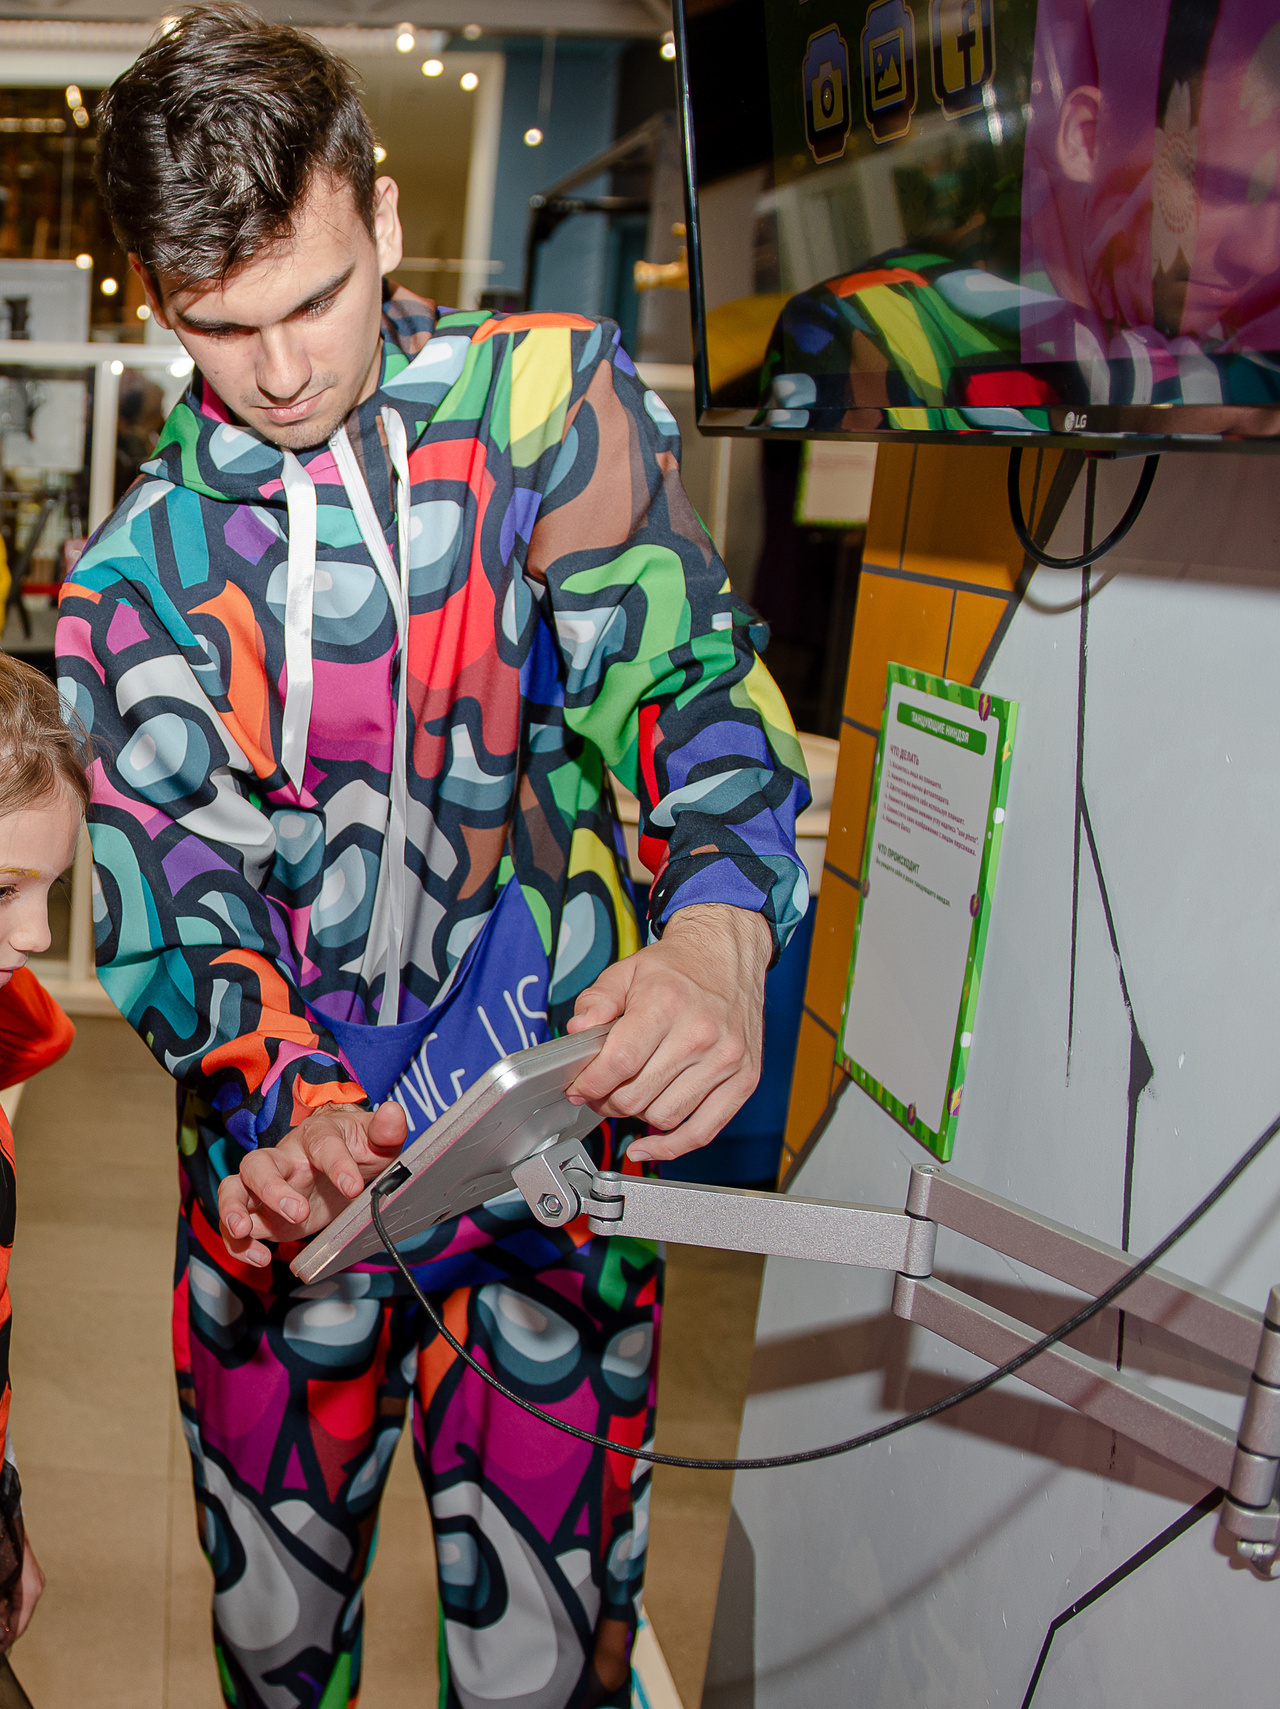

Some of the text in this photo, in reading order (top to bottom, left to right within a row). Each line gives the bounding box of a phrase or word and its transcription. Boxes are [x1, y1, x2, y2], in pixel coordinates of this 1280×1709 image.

[945, 725, 969, 743] НИНДЗЯ
[899, 749, 919, 766] ДЕЛАТЬ
[887, 848, 920, 874] ПРОИСХОДИТ
